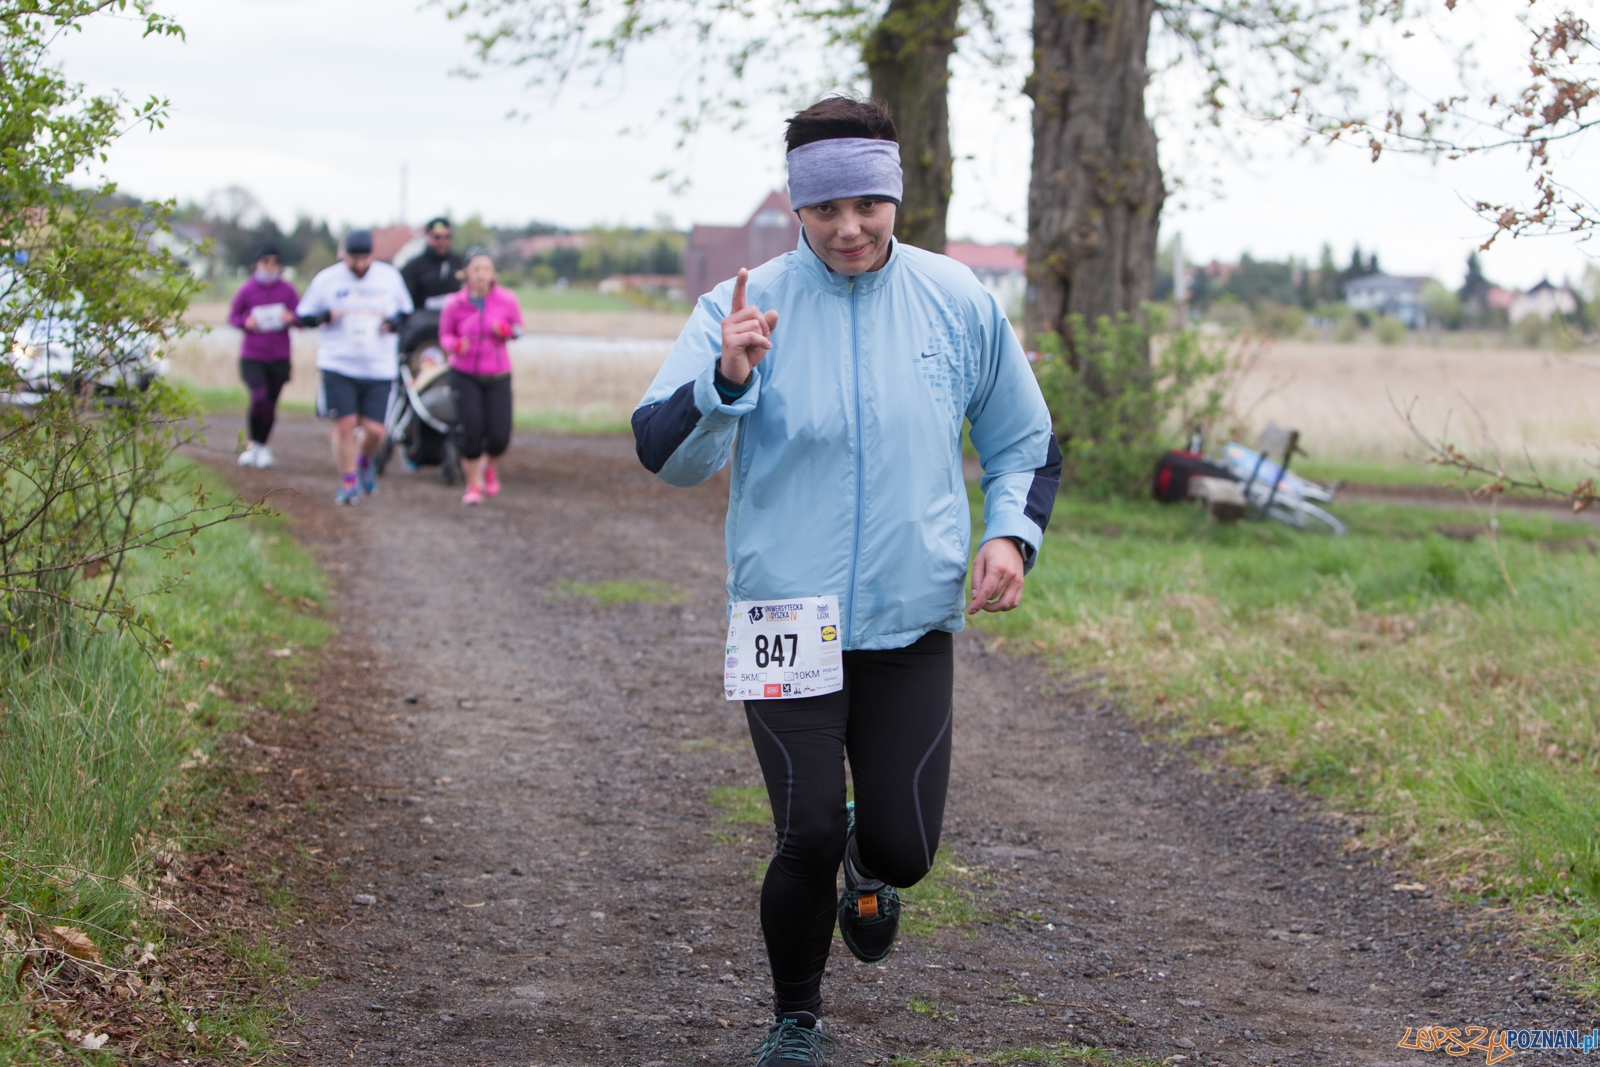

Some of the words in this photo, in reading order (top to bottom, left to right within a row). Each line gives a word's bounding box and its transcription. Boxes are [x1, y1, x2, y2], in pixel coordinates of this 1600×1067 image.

[764, 603, 804, 614] UNIWERSYTECKA
[790, 612, 798, 621] IV
[754, 633, 799, 669] 847
[740, 673, 758, 682] 5KM
[794, 670, 820, 680] 10KM
